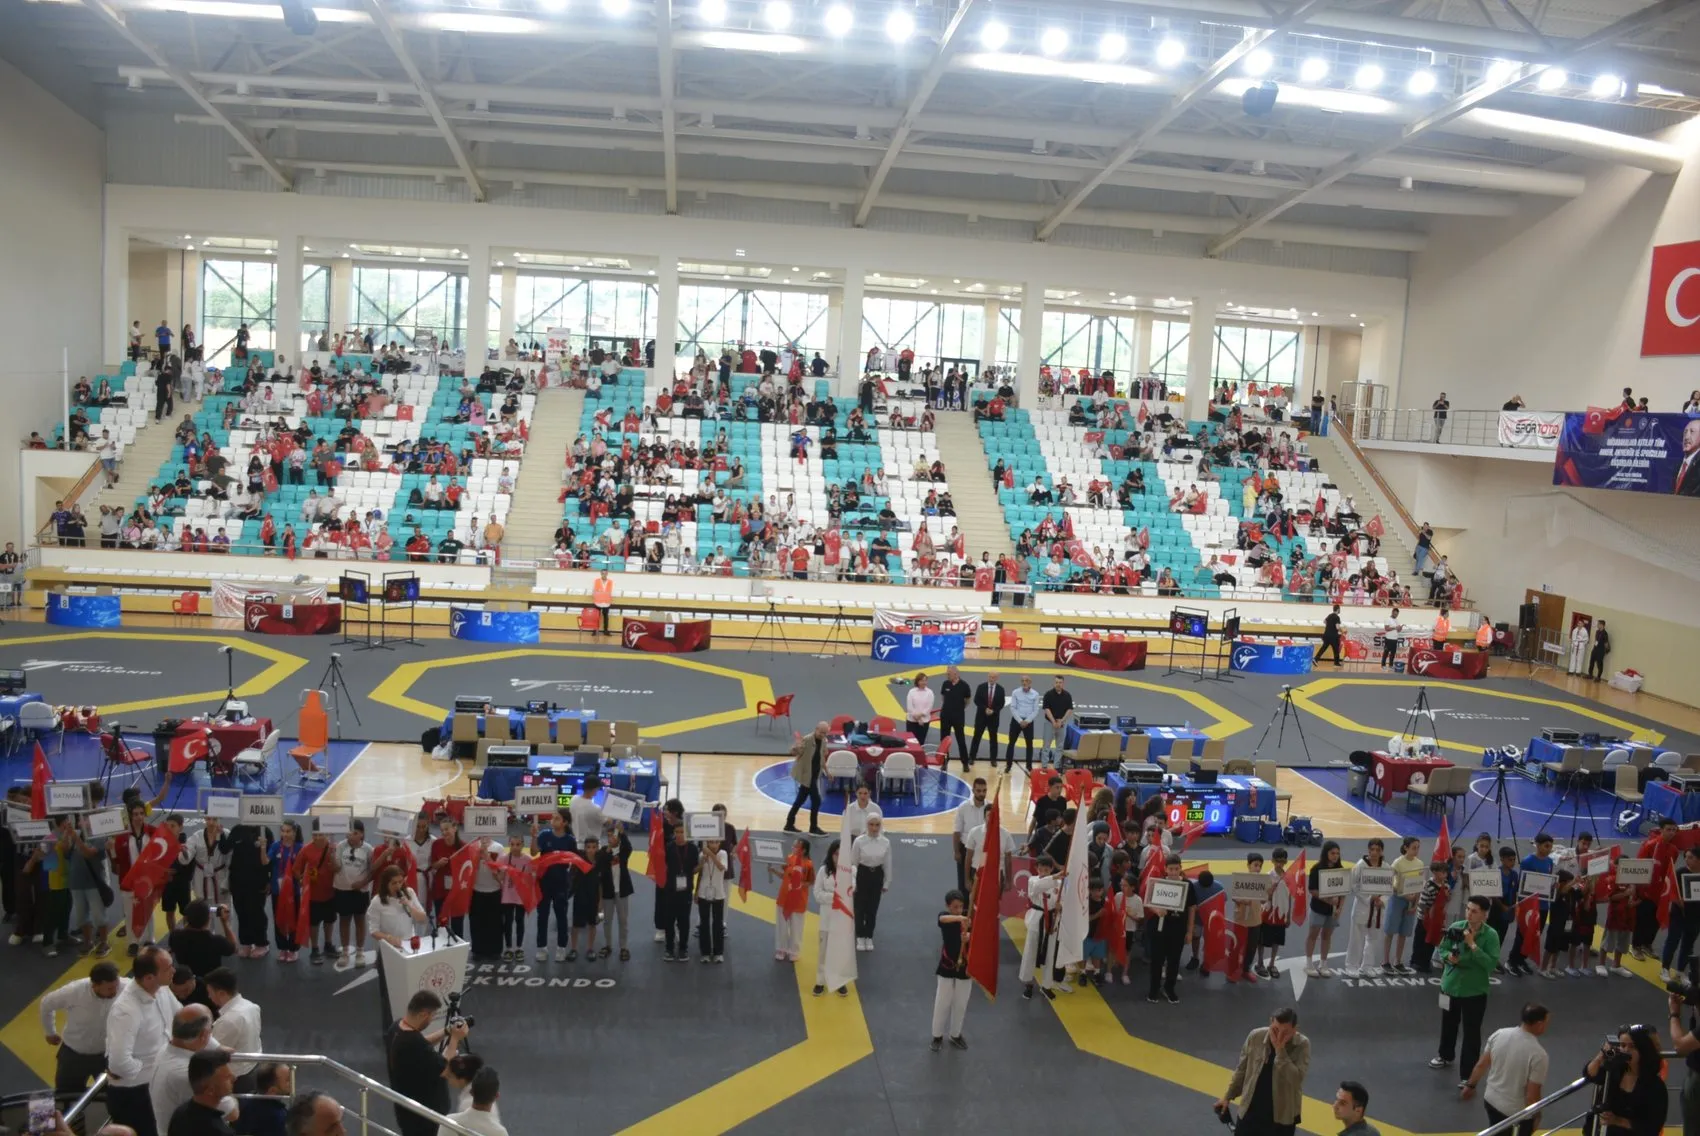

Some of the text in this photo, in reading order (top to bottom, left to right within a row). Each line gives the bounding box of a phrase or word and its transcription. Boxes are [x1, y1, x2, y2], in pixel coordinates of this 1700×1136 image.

[62, 599, 67, 608] 8
[285, 609, 291, 618] 8
[484, 615, 489, 623] 7
[667, 627, 673, 635] 7
[1092, 643, 1098, 651] 6
[1454, 654, 1460, 662] 5
[53, 792, 82, 800] BATMAN
[521, 795, 552, 806] ANTALYA
[250, 805, 275, 815] ADANA
[475, 812, 497, 826] İZMİR
[1170, 809, 1180, 823] 0
[1188, 811, 1203, 819] 1:30
[1211, 809, 1220, 822] 0
[1234, 881, 1266, 892] SAMSUN
[1327, 877, 1343, 887] ORDU
[1341, 977, 1502, 987] TAEKWOO
